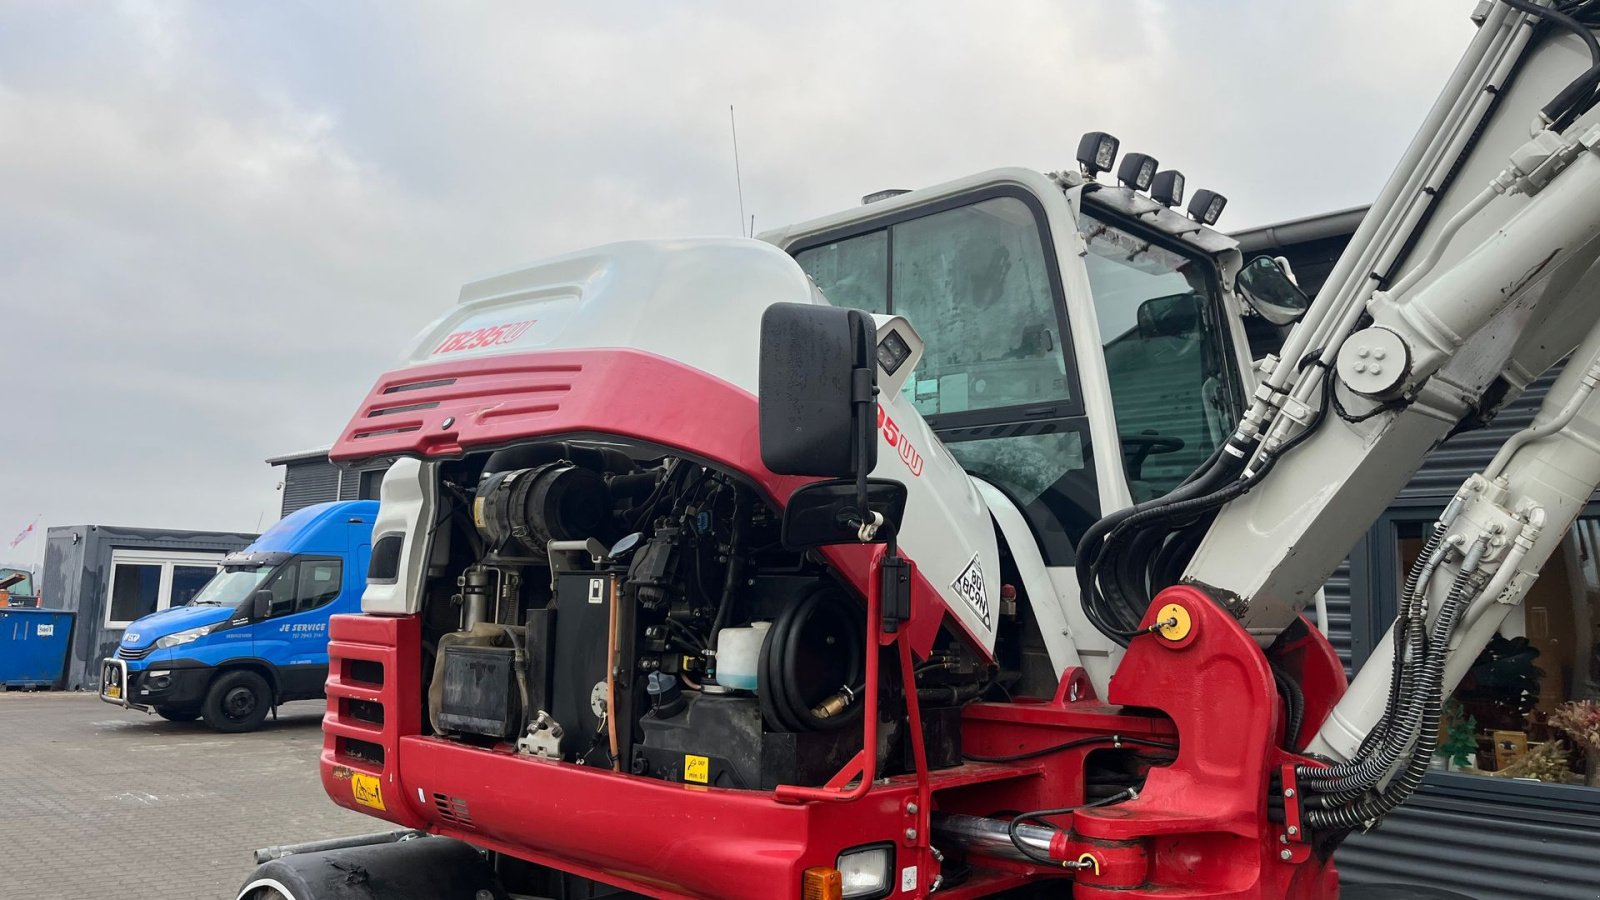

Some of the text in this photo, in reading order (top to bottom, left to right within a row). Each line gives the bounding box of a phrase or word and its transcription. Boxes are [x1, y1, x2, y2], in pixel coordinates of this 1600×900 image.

[432, 319, 538, 355] TB295W
[279, 623, 327, 632] JE SERVICE
